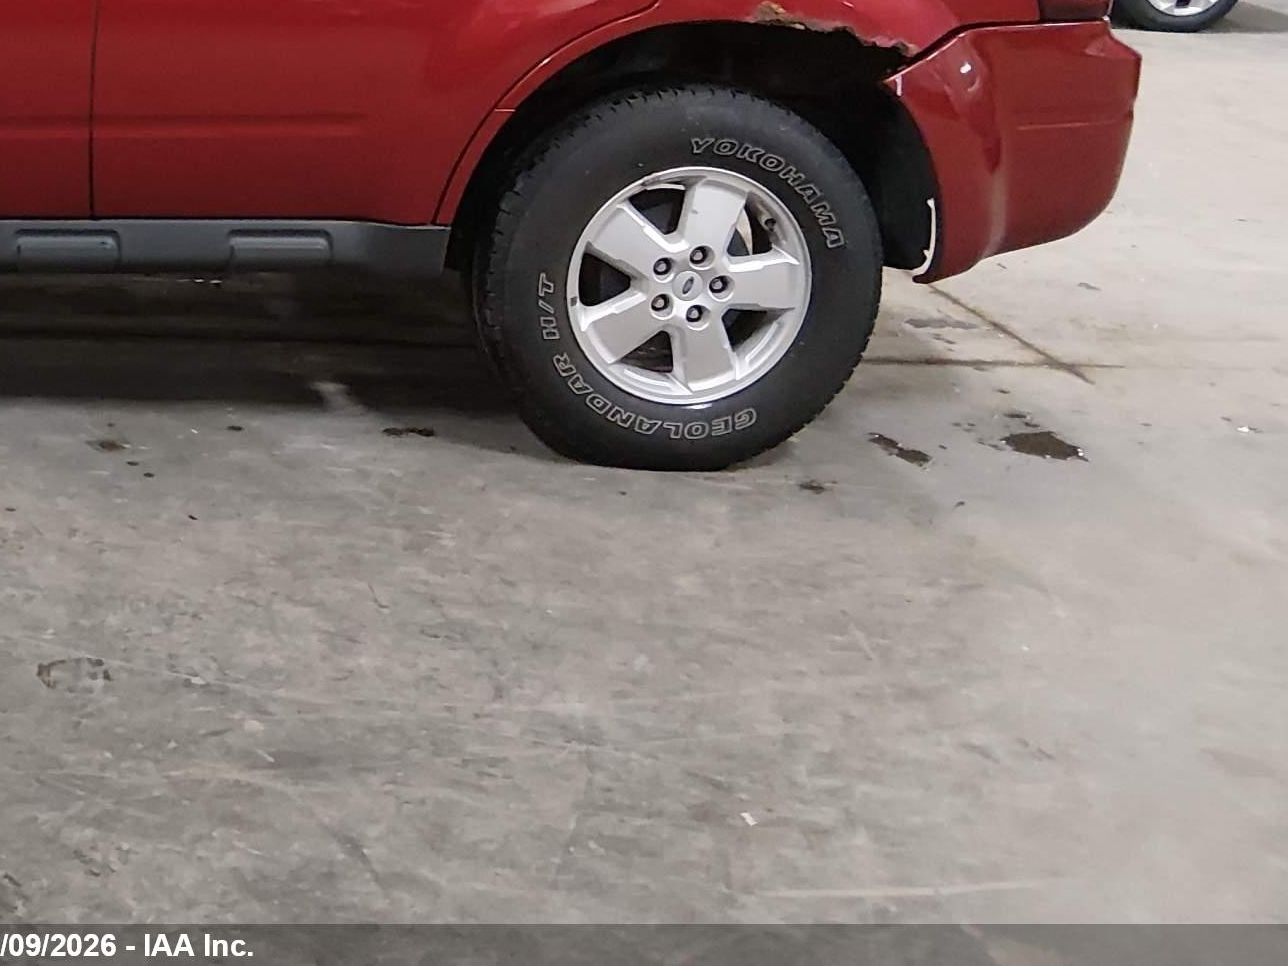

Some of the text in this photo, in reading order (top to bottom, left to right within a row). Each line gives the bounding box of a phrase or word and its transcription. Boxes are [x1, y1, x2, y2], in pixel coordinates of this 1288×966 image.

[691, 138, 845, 248] YOKOHAMA
[538, 273, 757, 439] GEOLANDAR H/T
